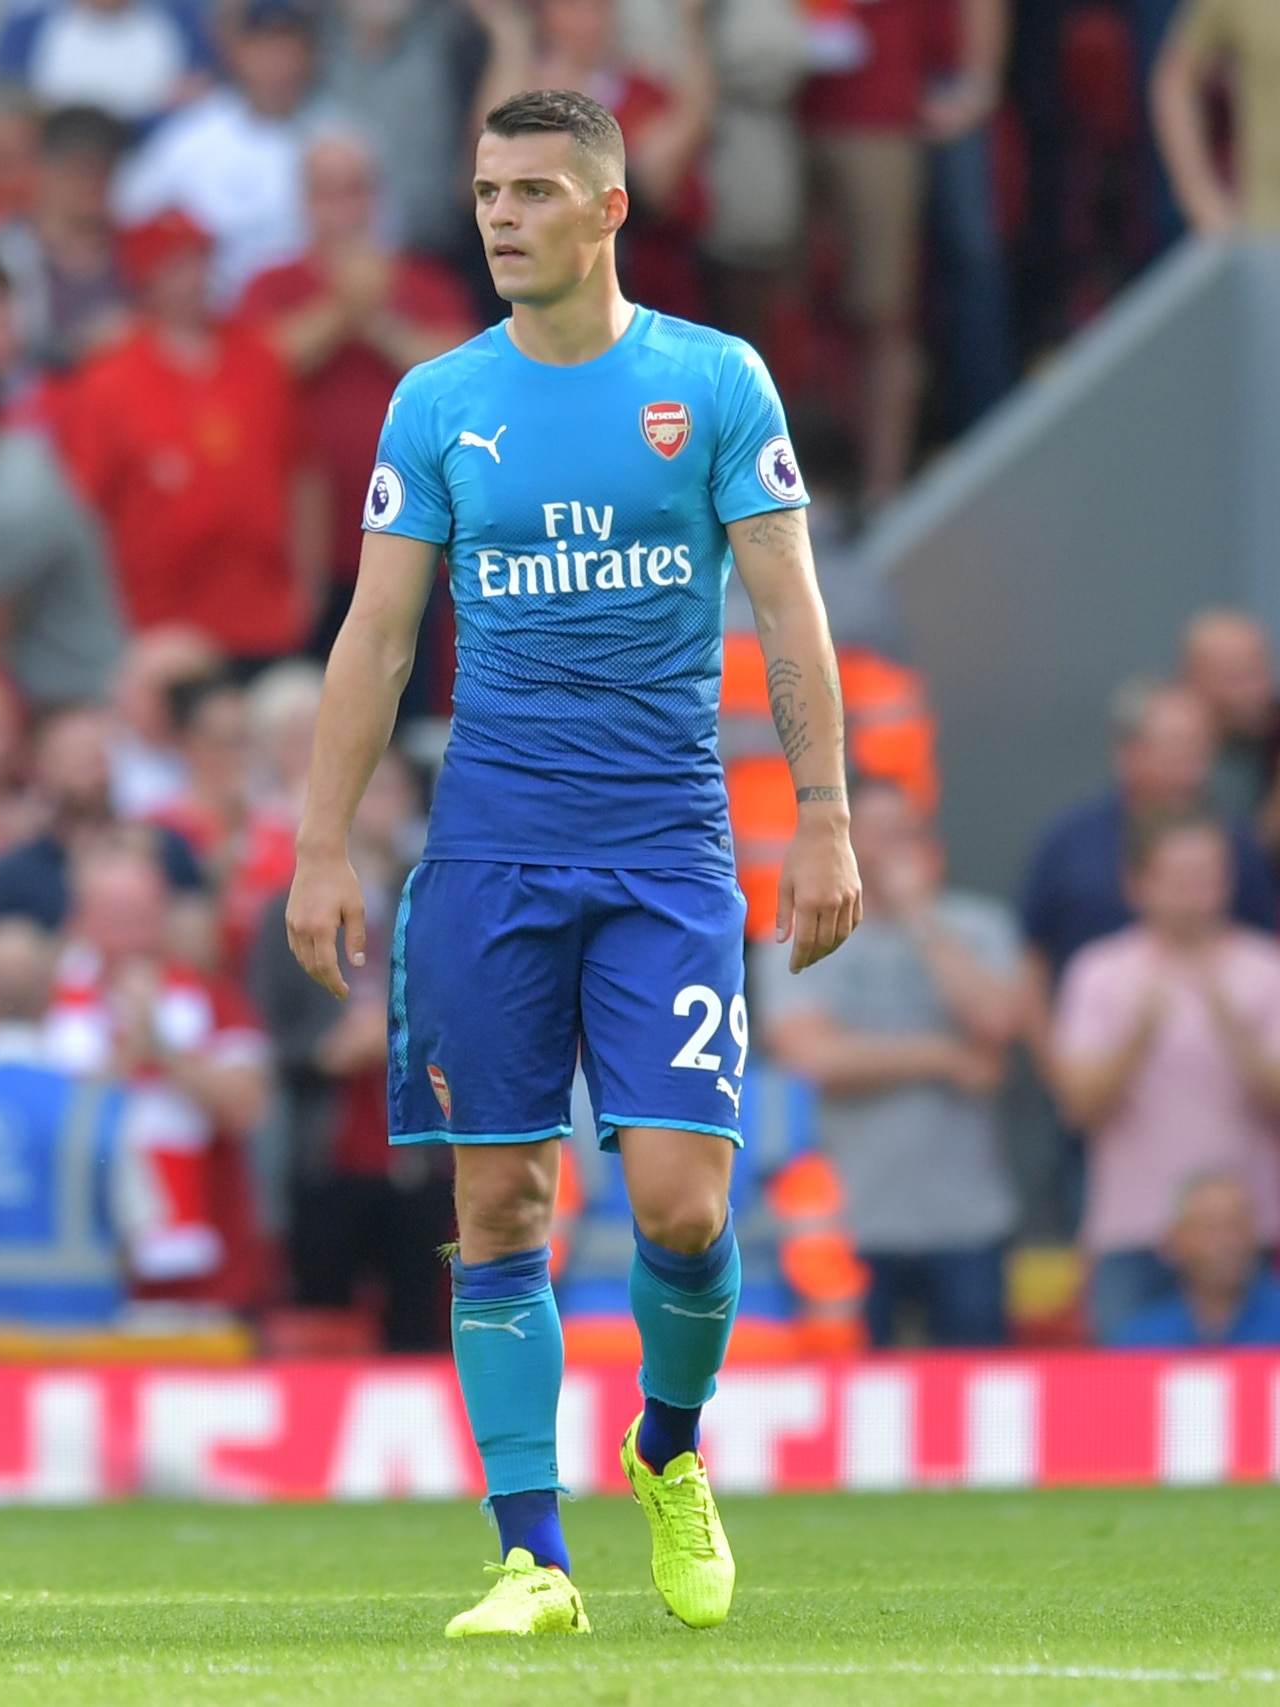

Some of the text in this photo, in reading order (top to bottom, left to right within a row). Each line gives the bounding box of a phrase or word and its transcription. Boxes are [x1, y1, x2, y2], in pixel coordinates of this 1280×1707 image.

[647, 410, 683, 421] Arsenal
[542, 501, 614, 541] Fly
[475, 540, 693, 597] Emirates
[670, 985, 748, 1077] 29
